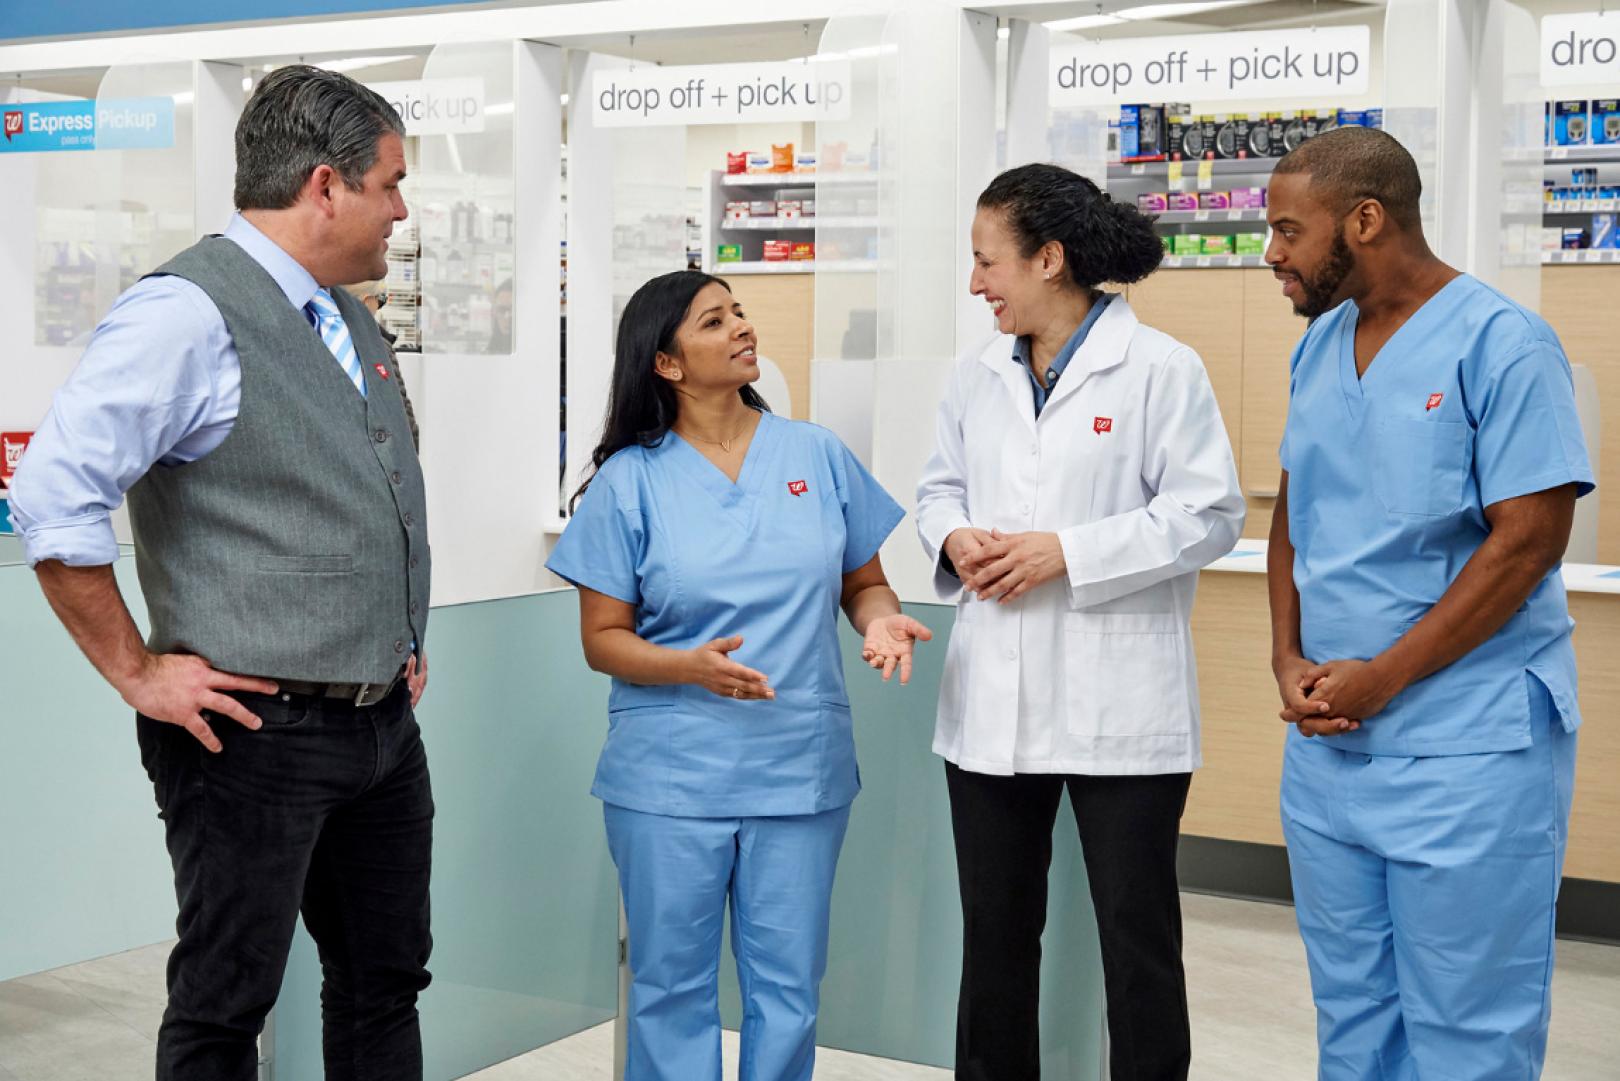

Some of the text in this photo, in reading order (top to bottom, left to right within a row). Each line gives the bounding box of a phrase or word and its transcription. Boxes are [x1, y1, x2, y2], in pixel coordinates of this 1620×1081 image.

[1057, 57, 1133, 95] drop
[1144, 51, 1188, 84] off
[1228, 46, 1303, 89] pick
[1313, 50, 1359, 85] up
[446, 96, 478, 124] up
[599, 83, 660, 117] drop
[669, 79, 705, 109] off
[737, 76, 797, 114] pick
[804, 80, 842, 112] up
[29, 109, 157, 135] Express Pickup
